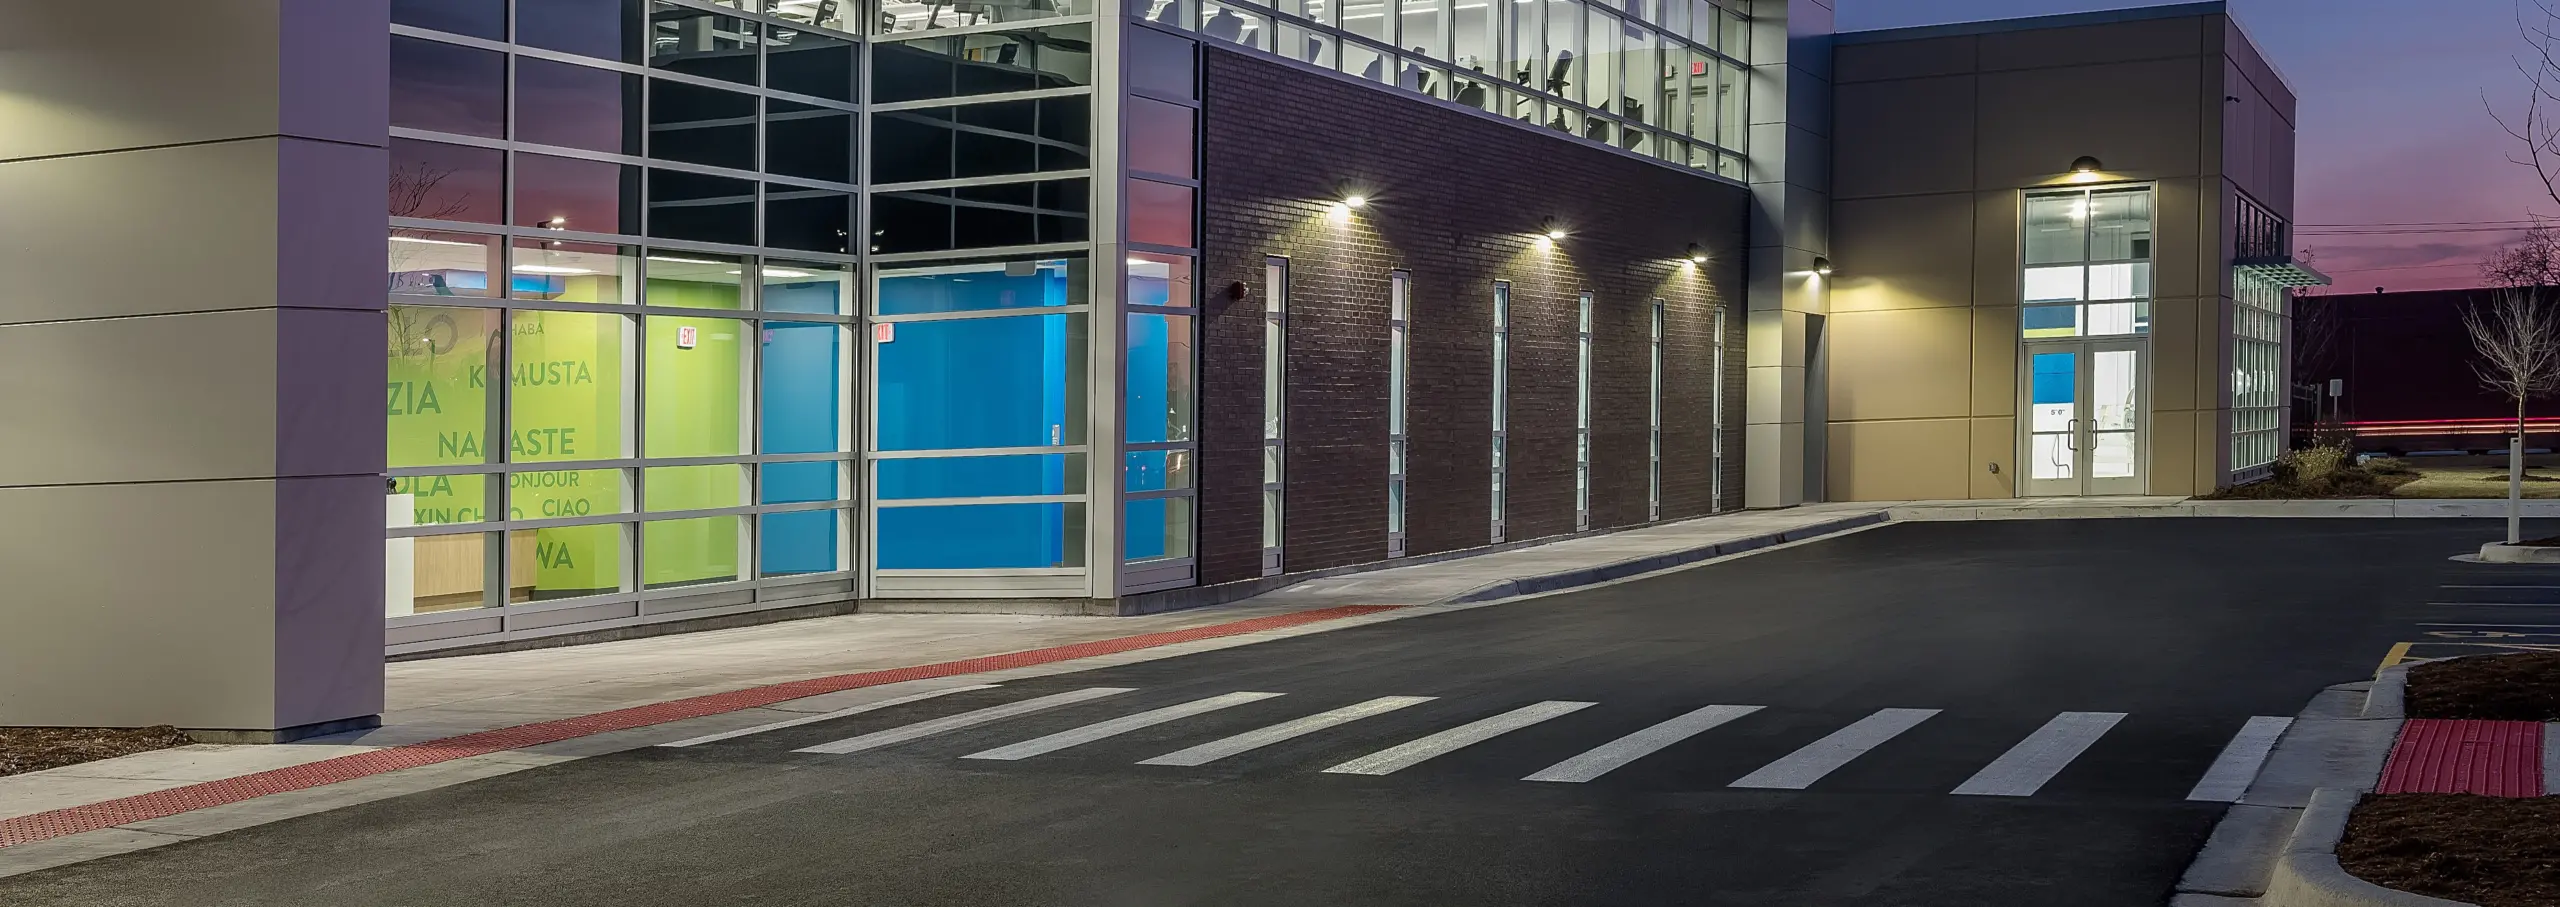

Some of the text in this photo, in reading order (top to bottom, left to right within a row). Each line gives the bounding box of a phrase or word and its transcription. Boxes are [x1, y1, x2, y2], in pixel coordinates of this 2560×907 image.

[1692, 61, 1704, 74] XIT
[683, 328, 695, 345] EXIT
[877, 323, 889, 341] XIT
[469, 360, 592, 389] KMUSTA
[438, 428, 576, 458] NAASTE
[510, 471, 579, 489] ONJOUR
[542, 498, 590, 517] CIAO
